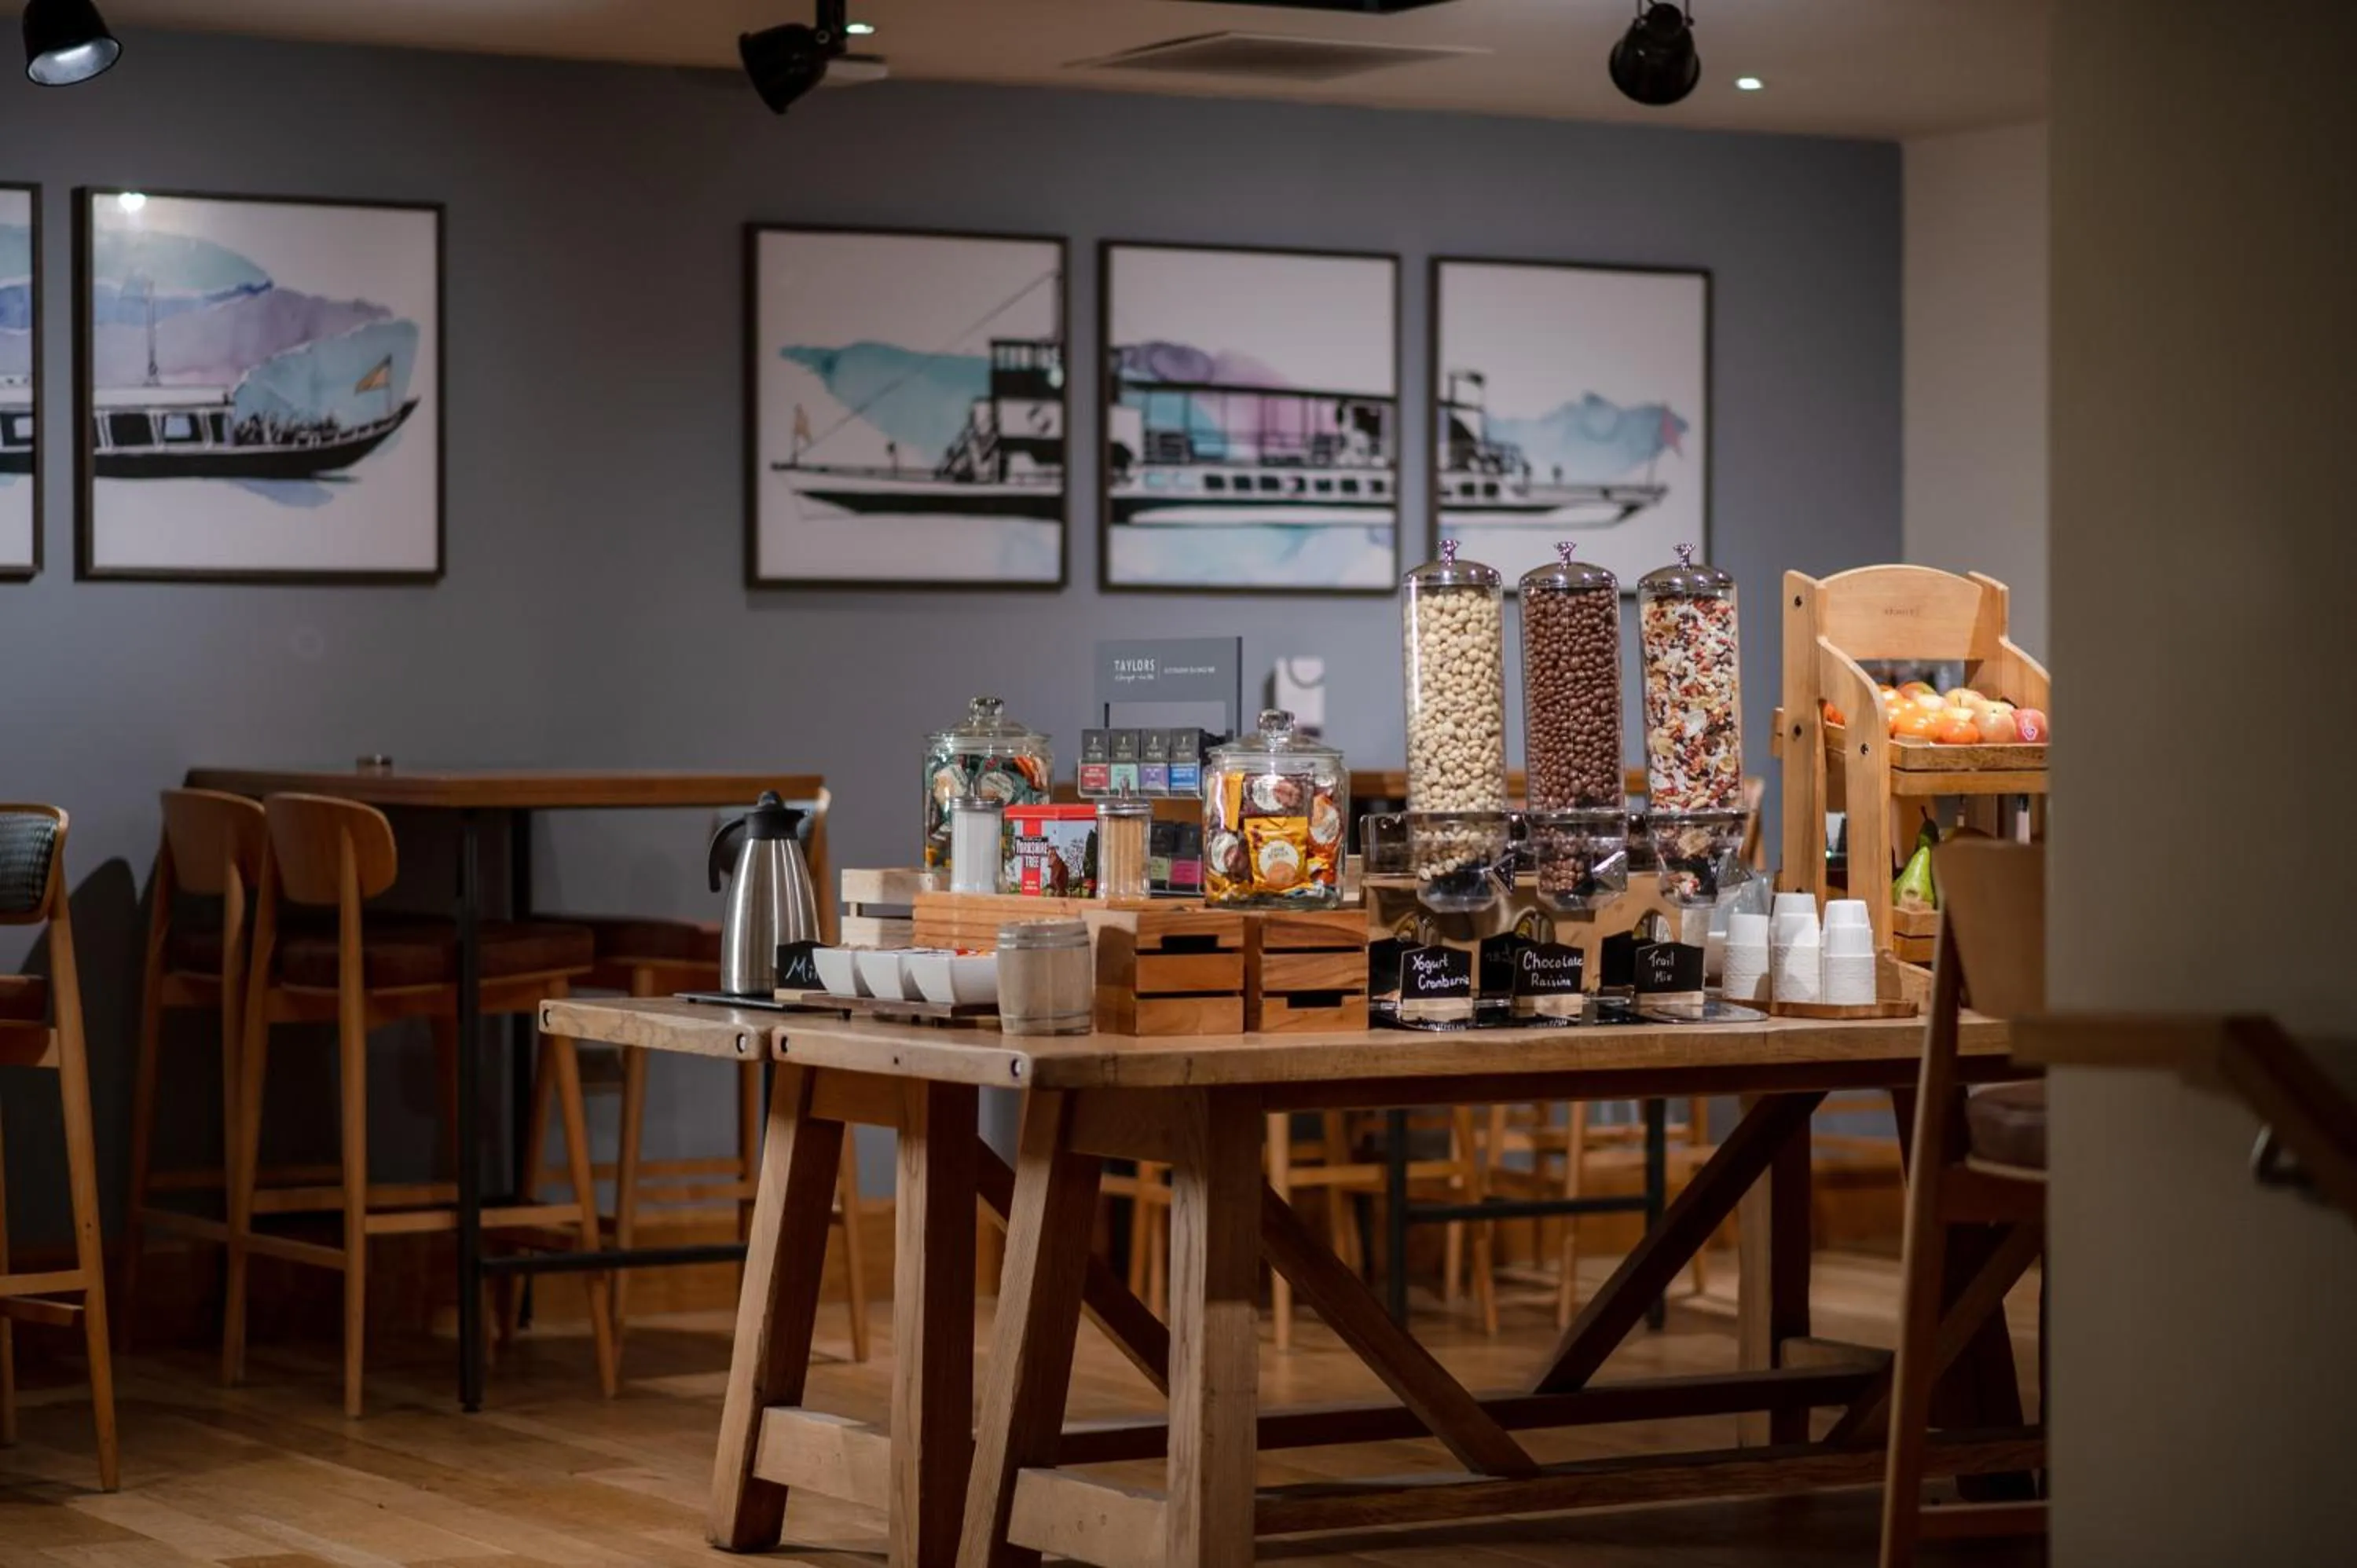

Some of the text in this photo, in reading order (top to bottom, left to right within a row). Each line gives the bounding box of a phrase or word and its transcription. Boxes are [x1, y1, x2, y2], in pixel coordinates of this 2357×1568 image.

[1114, 658, 1154, 672] TAYLORS
[1412, 953, 1449, 974] Yogurt
[1523, 949, 1585, 971] Chocolate
[1648, 949, 1675, 968] Trail
